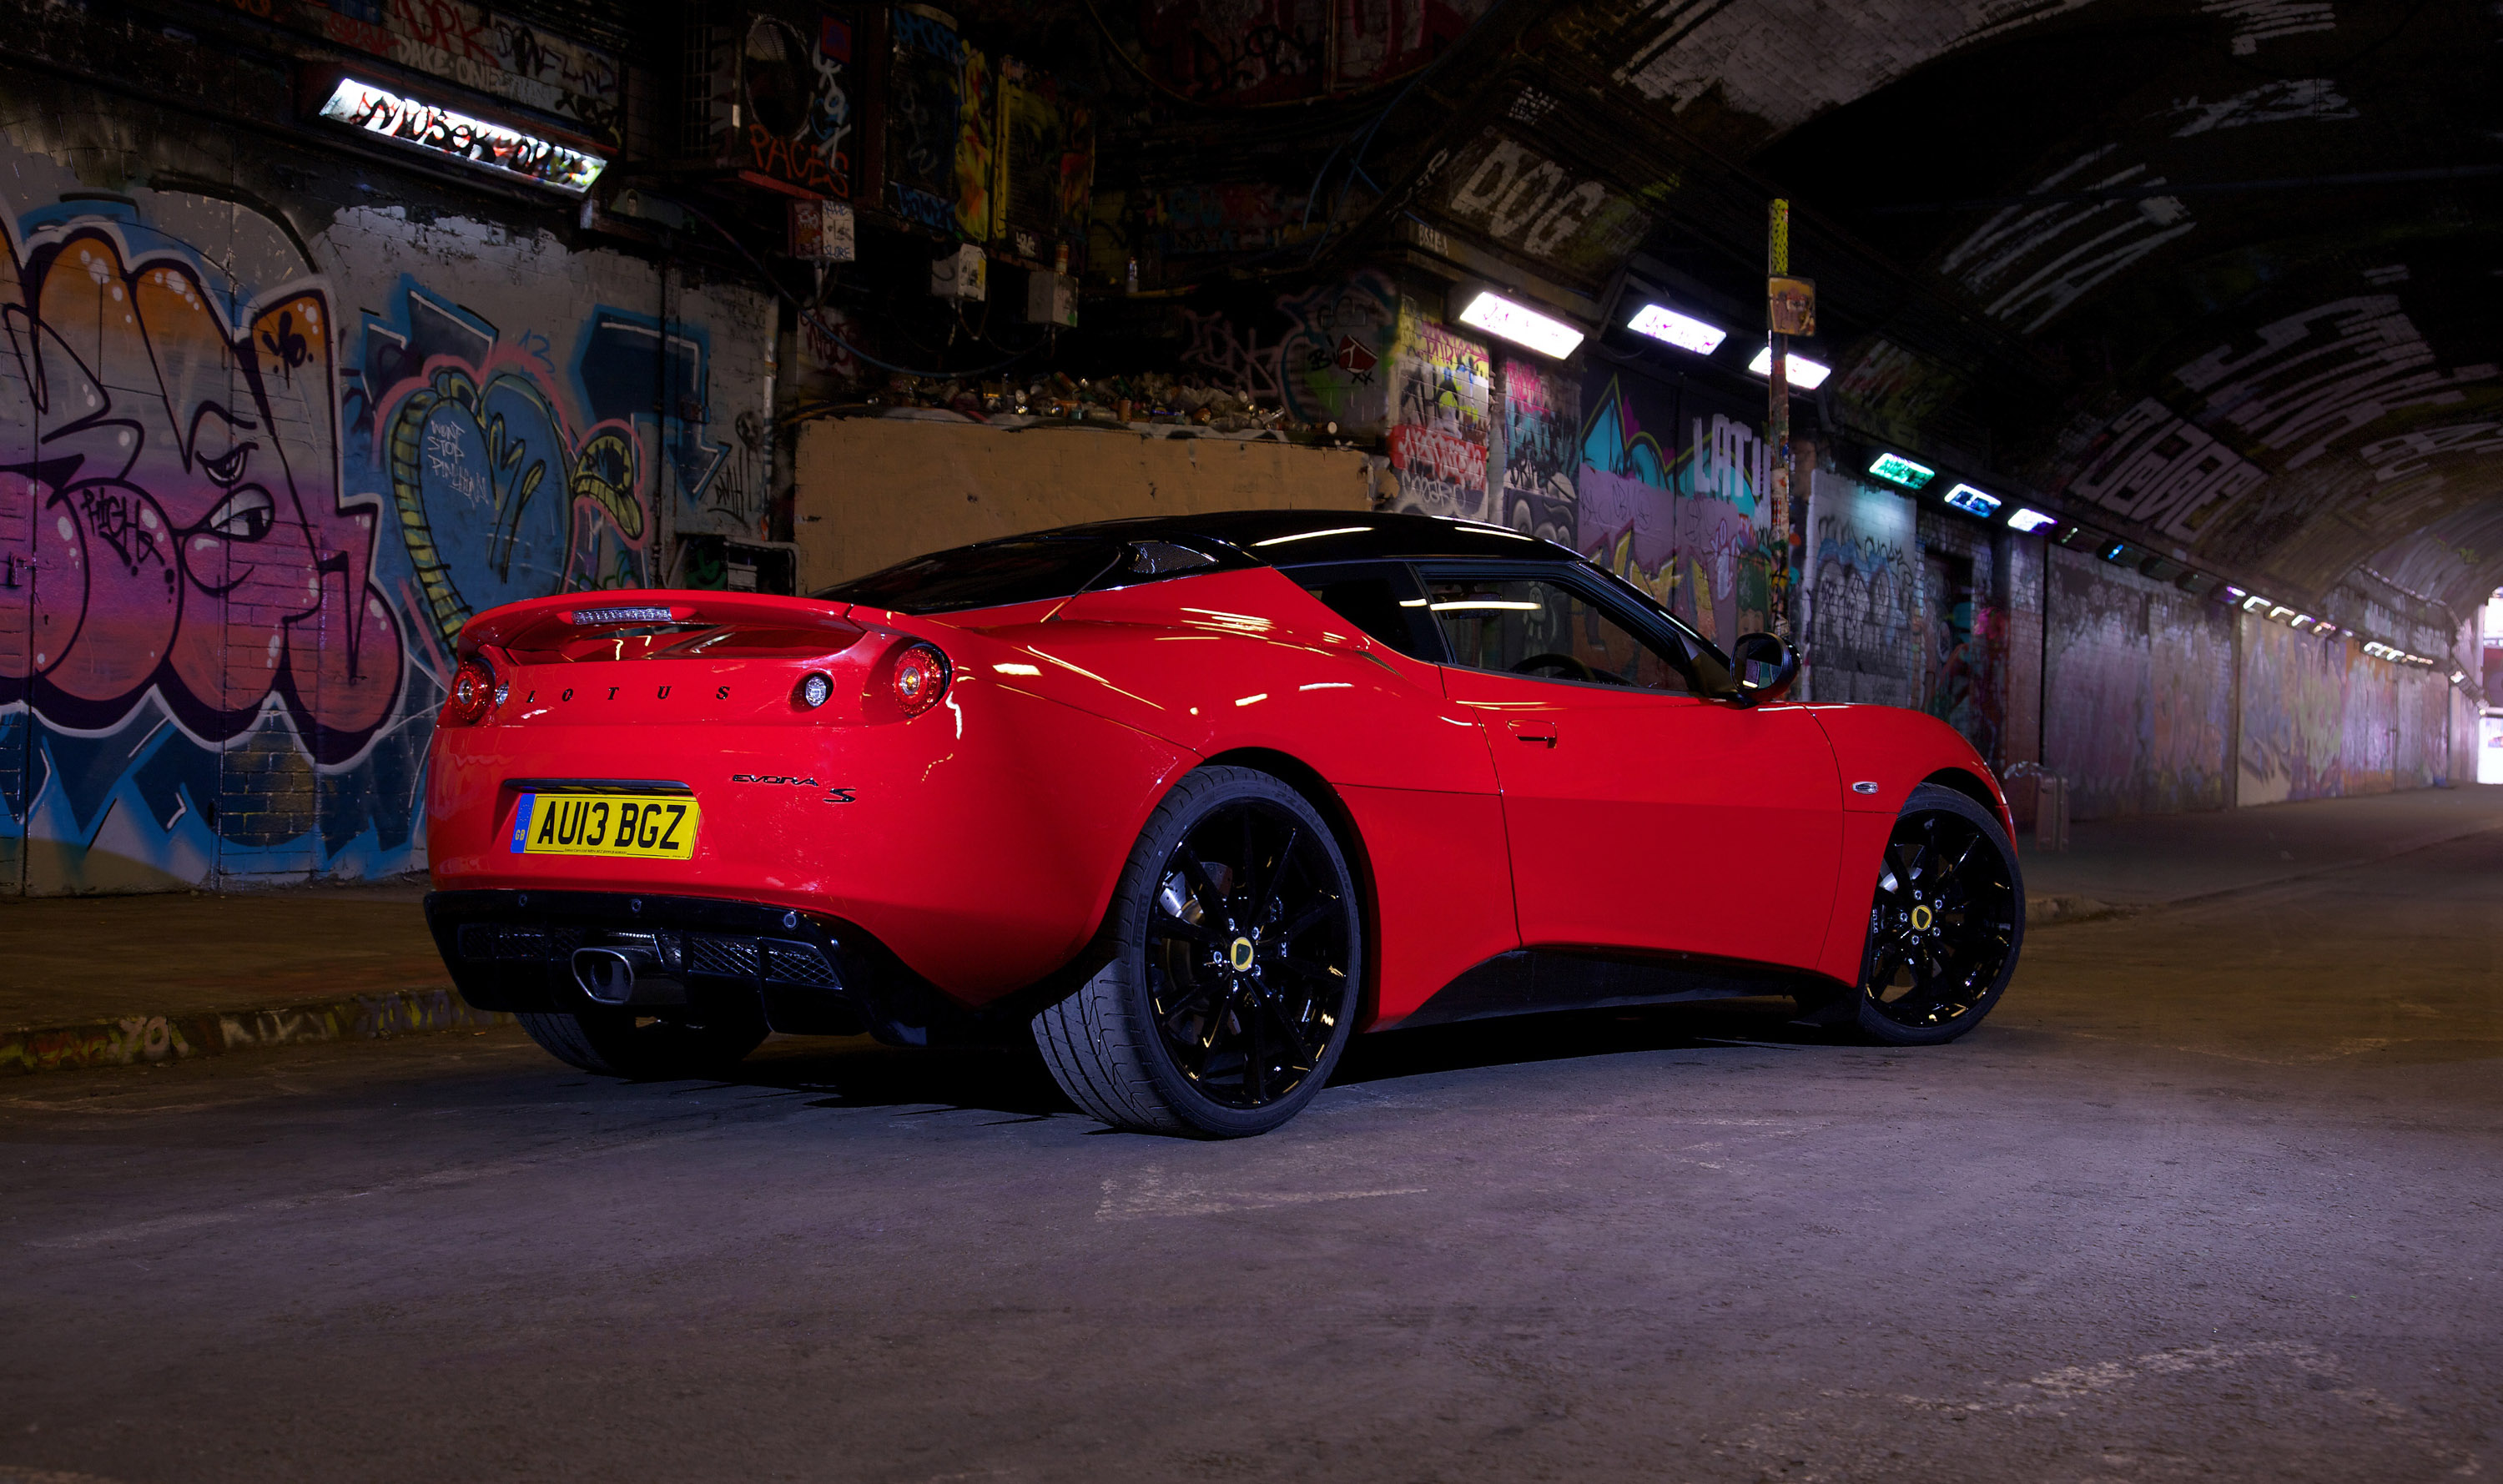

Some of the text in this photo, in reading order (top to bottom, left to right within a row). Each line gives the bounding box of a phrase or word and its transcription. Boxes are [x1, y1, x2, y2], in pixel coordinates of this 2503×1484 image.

[427, 435, 465, 464] STOP
[526, 685, 731, 704] LOTUS
[732, 774, 819, 787] EVORA
[514, 829, 526, 841] GB
[536, 801, 687, 850] AU13 BGZ
